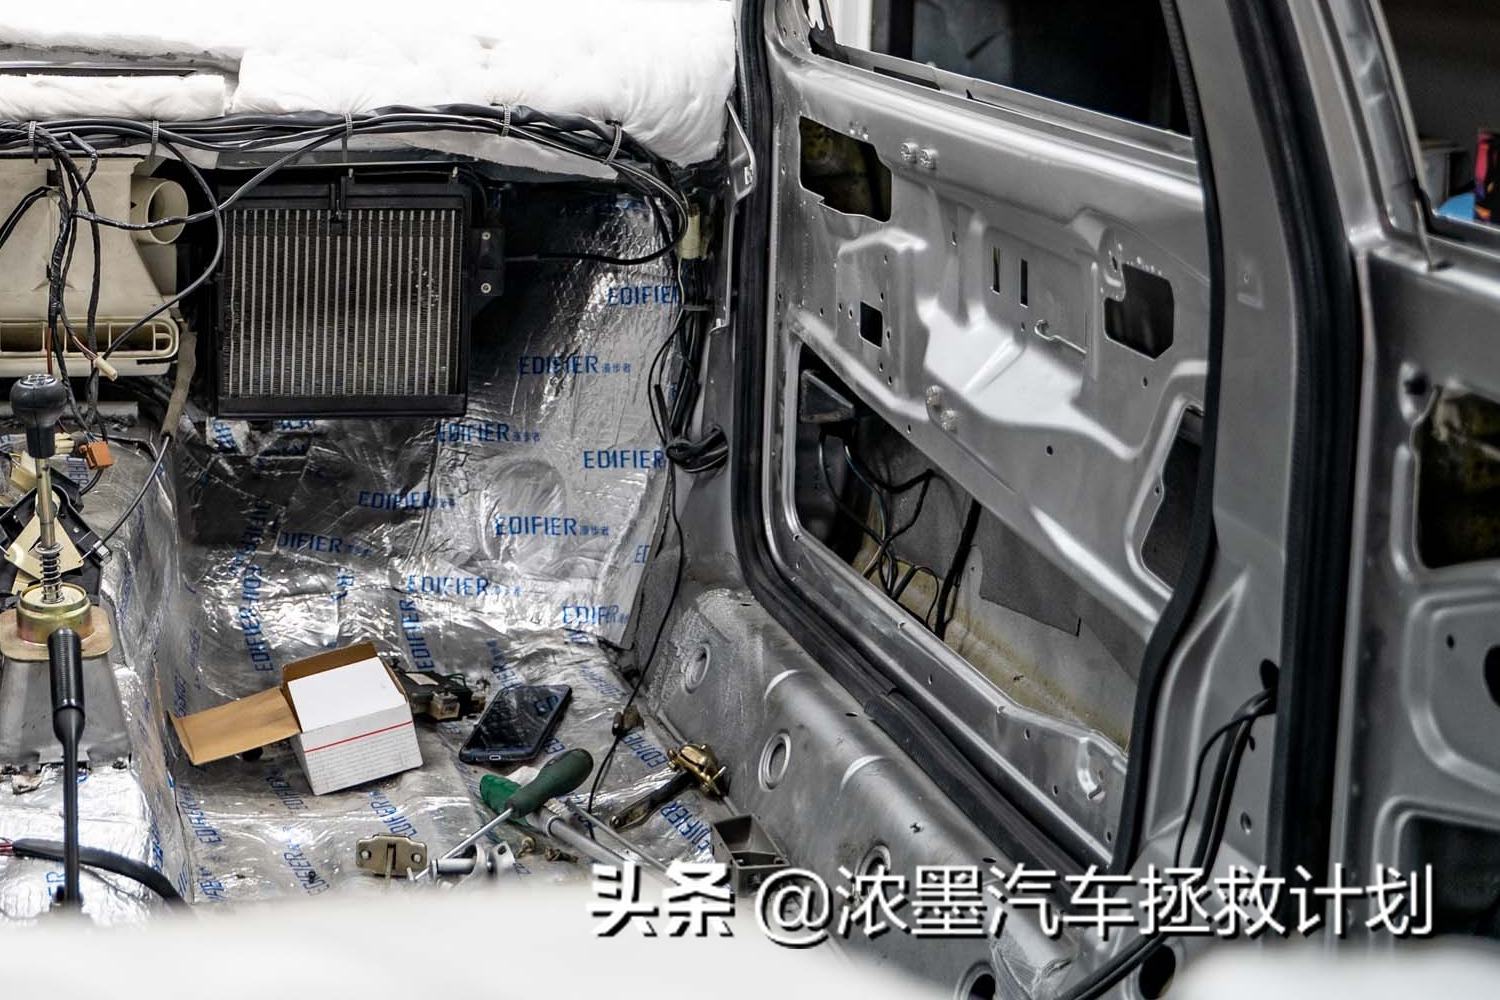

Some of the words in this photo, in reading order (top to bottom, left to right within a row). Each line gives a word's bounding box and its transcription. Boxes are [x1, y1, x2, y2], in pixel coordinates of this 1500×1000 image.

[519, 355, 598, 376] EDIFIER
[437, 423, 510, 443] EDIFIER
[583, 450, 664, 470] EDIFIER
[358, 490, 430, 512] EDIFIER
[495, 516, 577, 536] EDIFIER
[407, 575, 490, 597] EDIFIER
[400, 600, 435, 671] EDIFIER
[660, 801, 713, 853] EDIFIER
